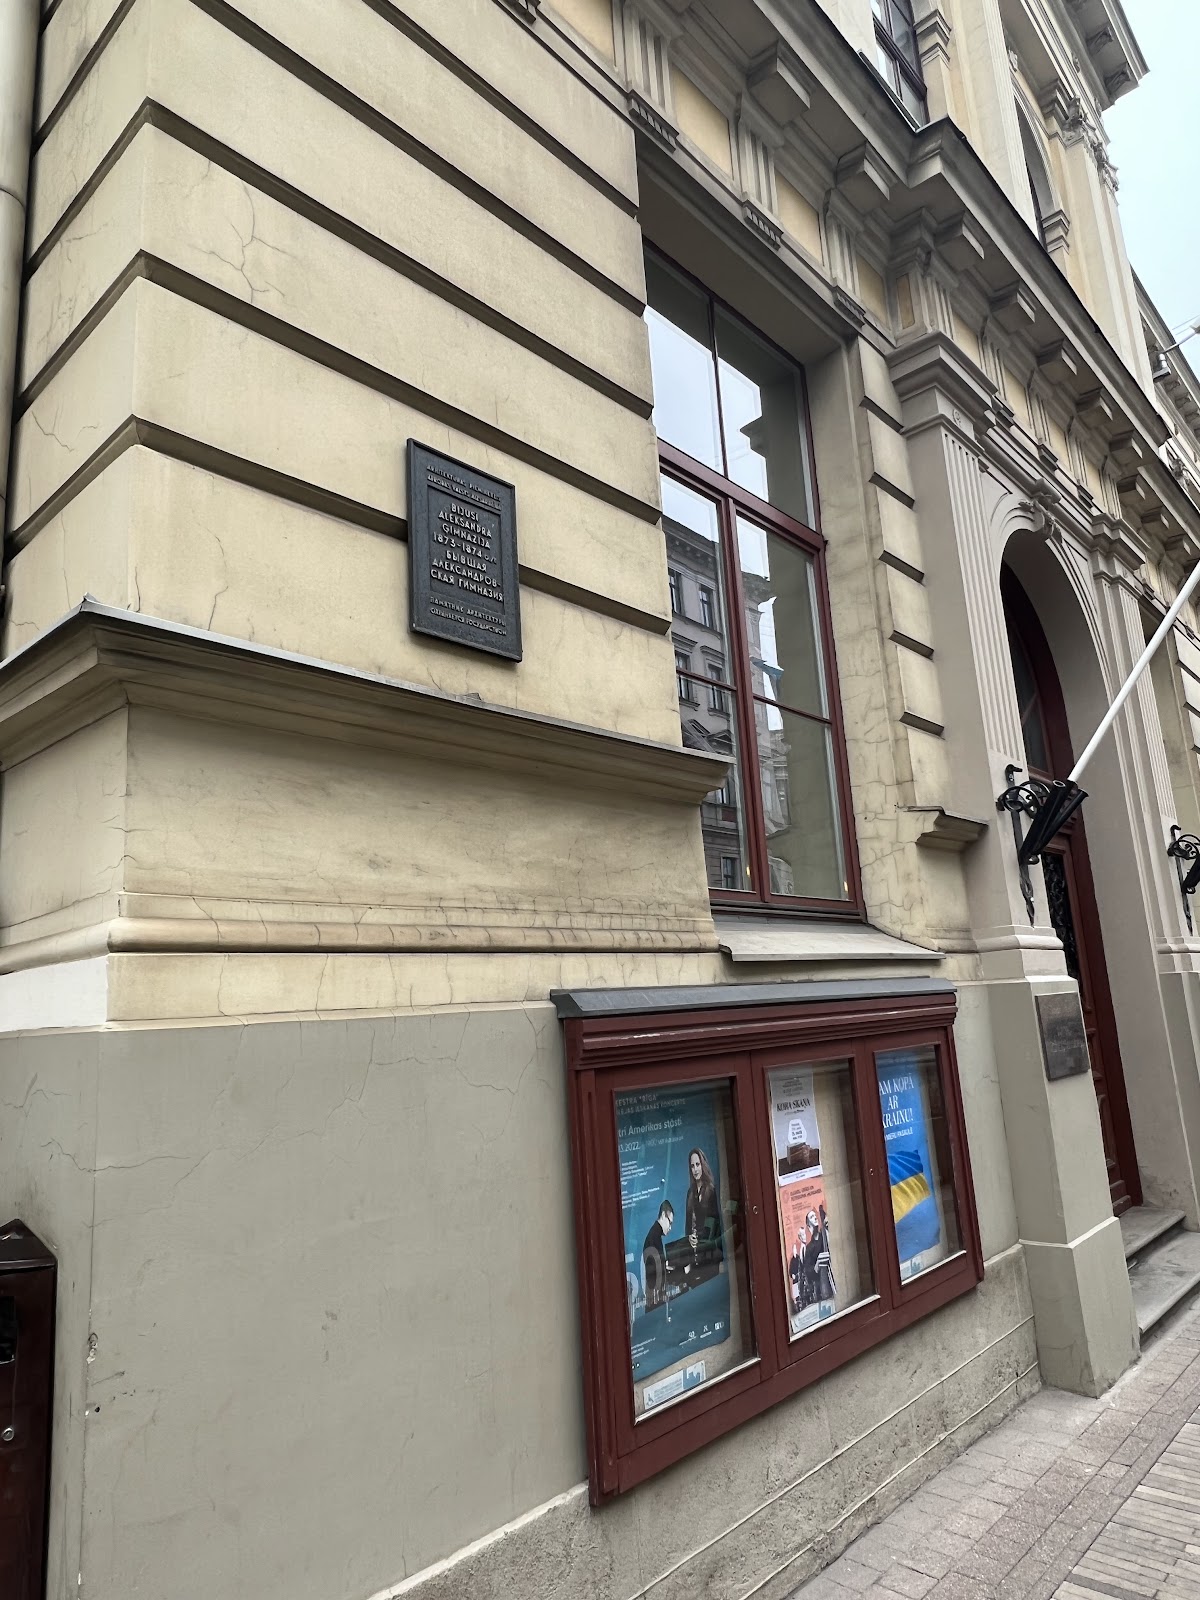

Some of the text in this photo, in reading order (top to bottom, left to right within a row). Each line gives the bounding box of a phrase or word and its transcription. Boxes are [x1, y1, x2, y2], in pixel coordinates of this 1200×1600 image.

[438, 510, 492, 538] ALEKSANDRA
[446, 550, 487, 572] БЫВШАЯ
[430, 569, 504, 602] СКАЯ ГИМНАЗИЯ
[887, 1095, 899, 1111] AR
[628, 1120, 662, 1136] Amerikas
